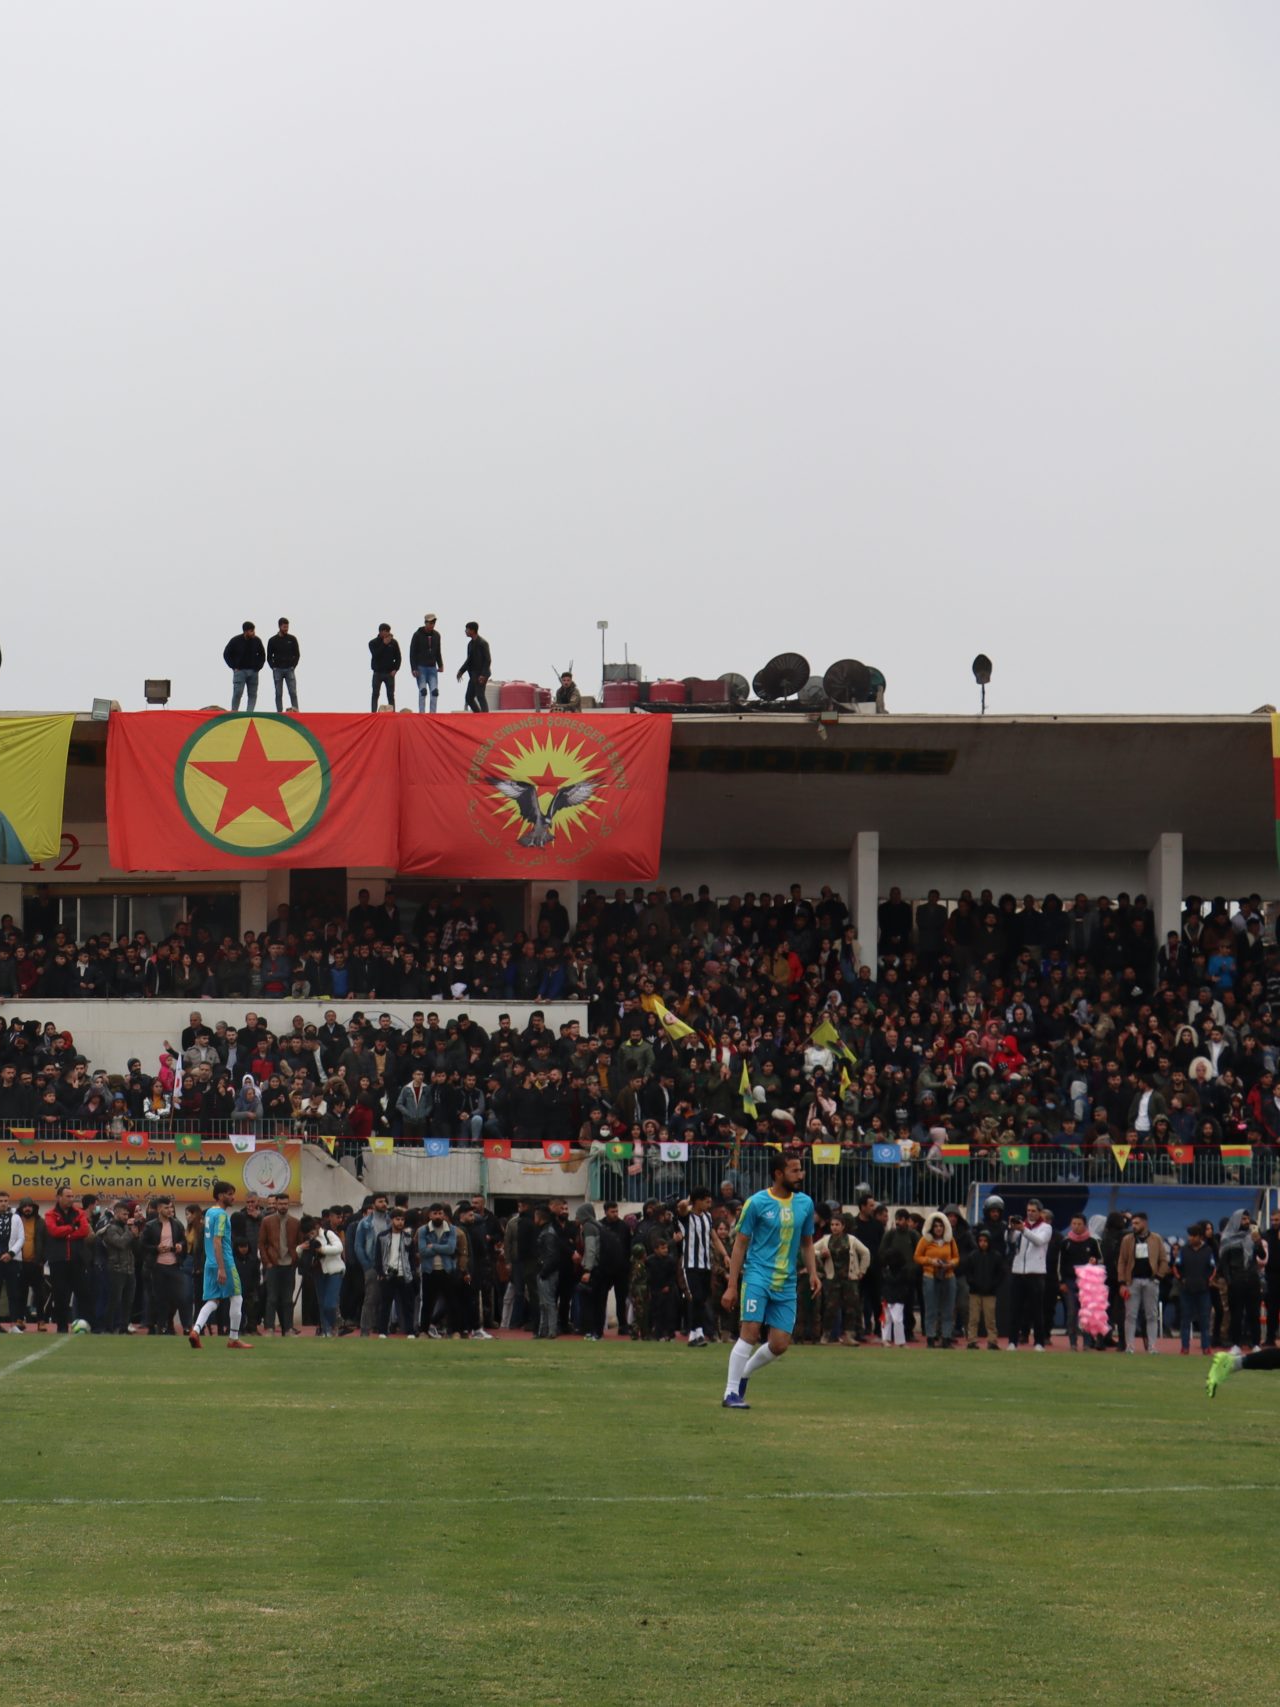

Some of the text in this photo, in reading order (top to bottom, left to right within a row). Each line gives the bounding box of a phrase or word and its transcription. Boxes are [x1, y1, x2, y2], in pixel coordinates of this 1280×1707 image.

[7, 1147, 94, 1171] والرياضة
[98, 1147, 172, 1170] الشباب
[12, 1174, 71, 1188] Desteya
[80, 1174, 143, 1187] Ciwanan
[148, 1174, 157, 1187] û
[781, 1207, 791, 1221] 15
[746, 1299, 758, 1313] 15
